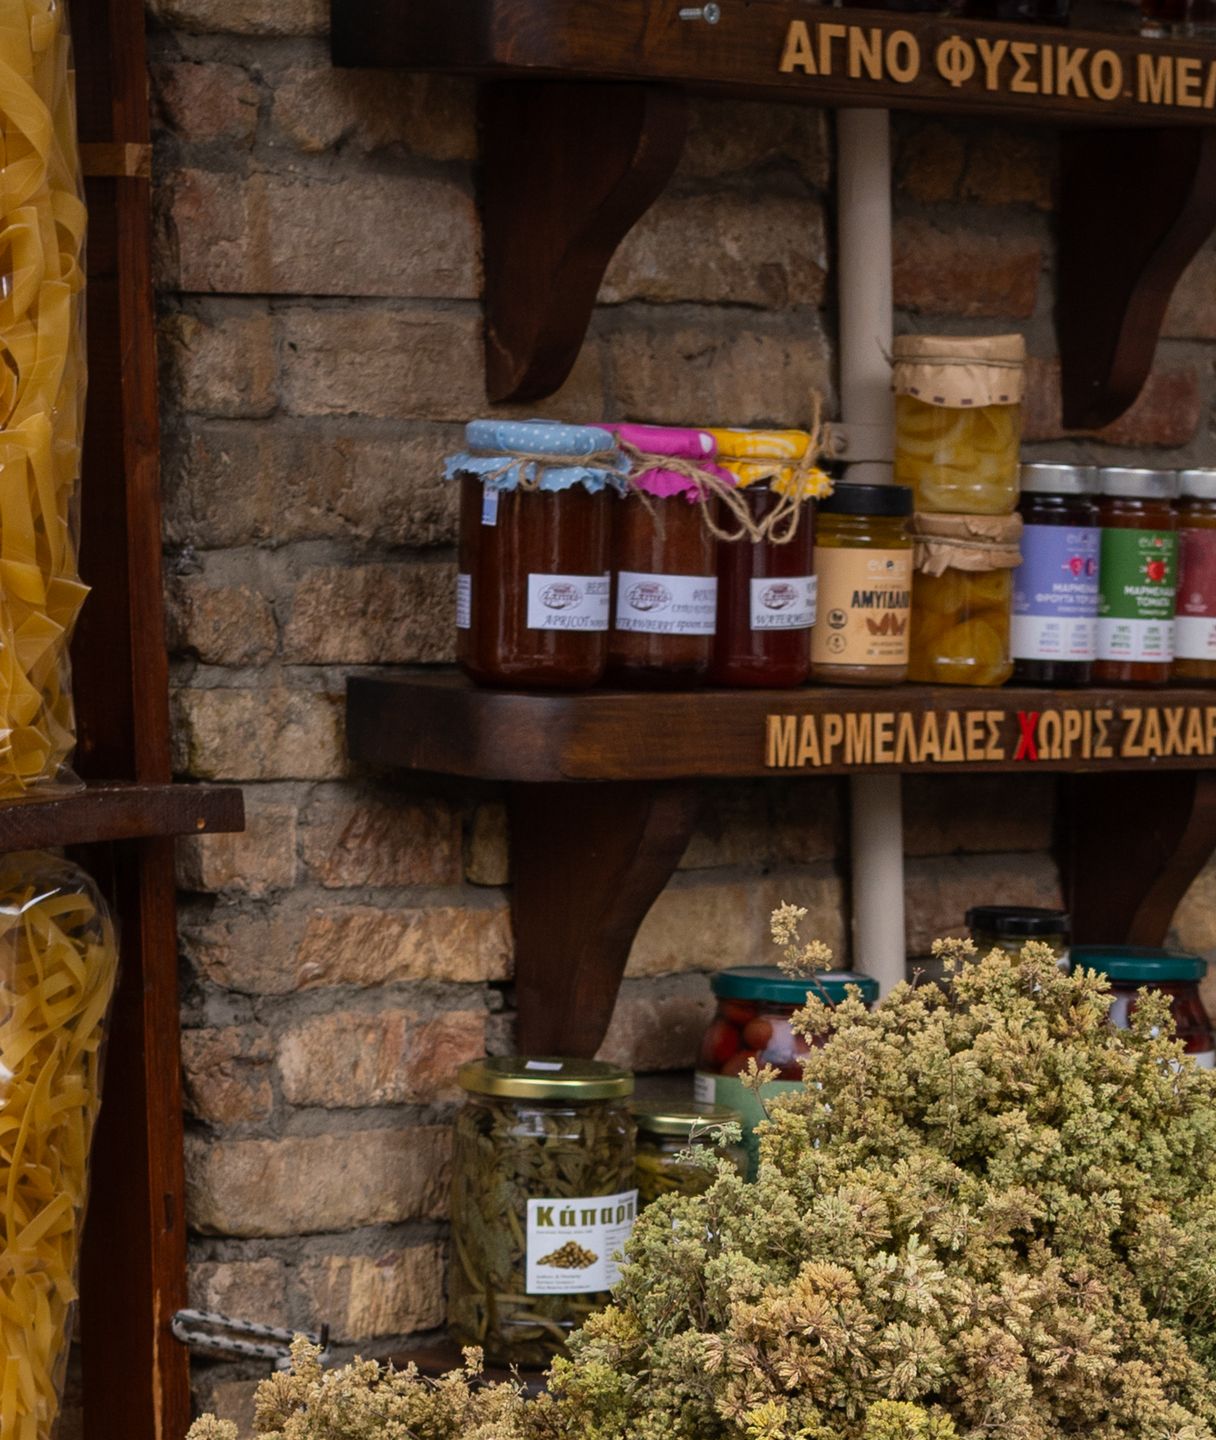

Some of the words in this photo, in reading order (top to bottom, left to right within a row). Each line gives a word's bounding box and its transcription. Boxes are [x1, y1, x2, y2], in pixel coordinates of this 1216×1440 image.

[779, 19, 921, 84] ΑΓΝΟ
[935, 35, 1123, 101] ΦΥΣΙΚΟ
[765, 710, 1005, 769] ΜΑΡΜΕΛΑΔΕΣ
[1013, 709, 1114, 762] ΧΩΡΙΣ
